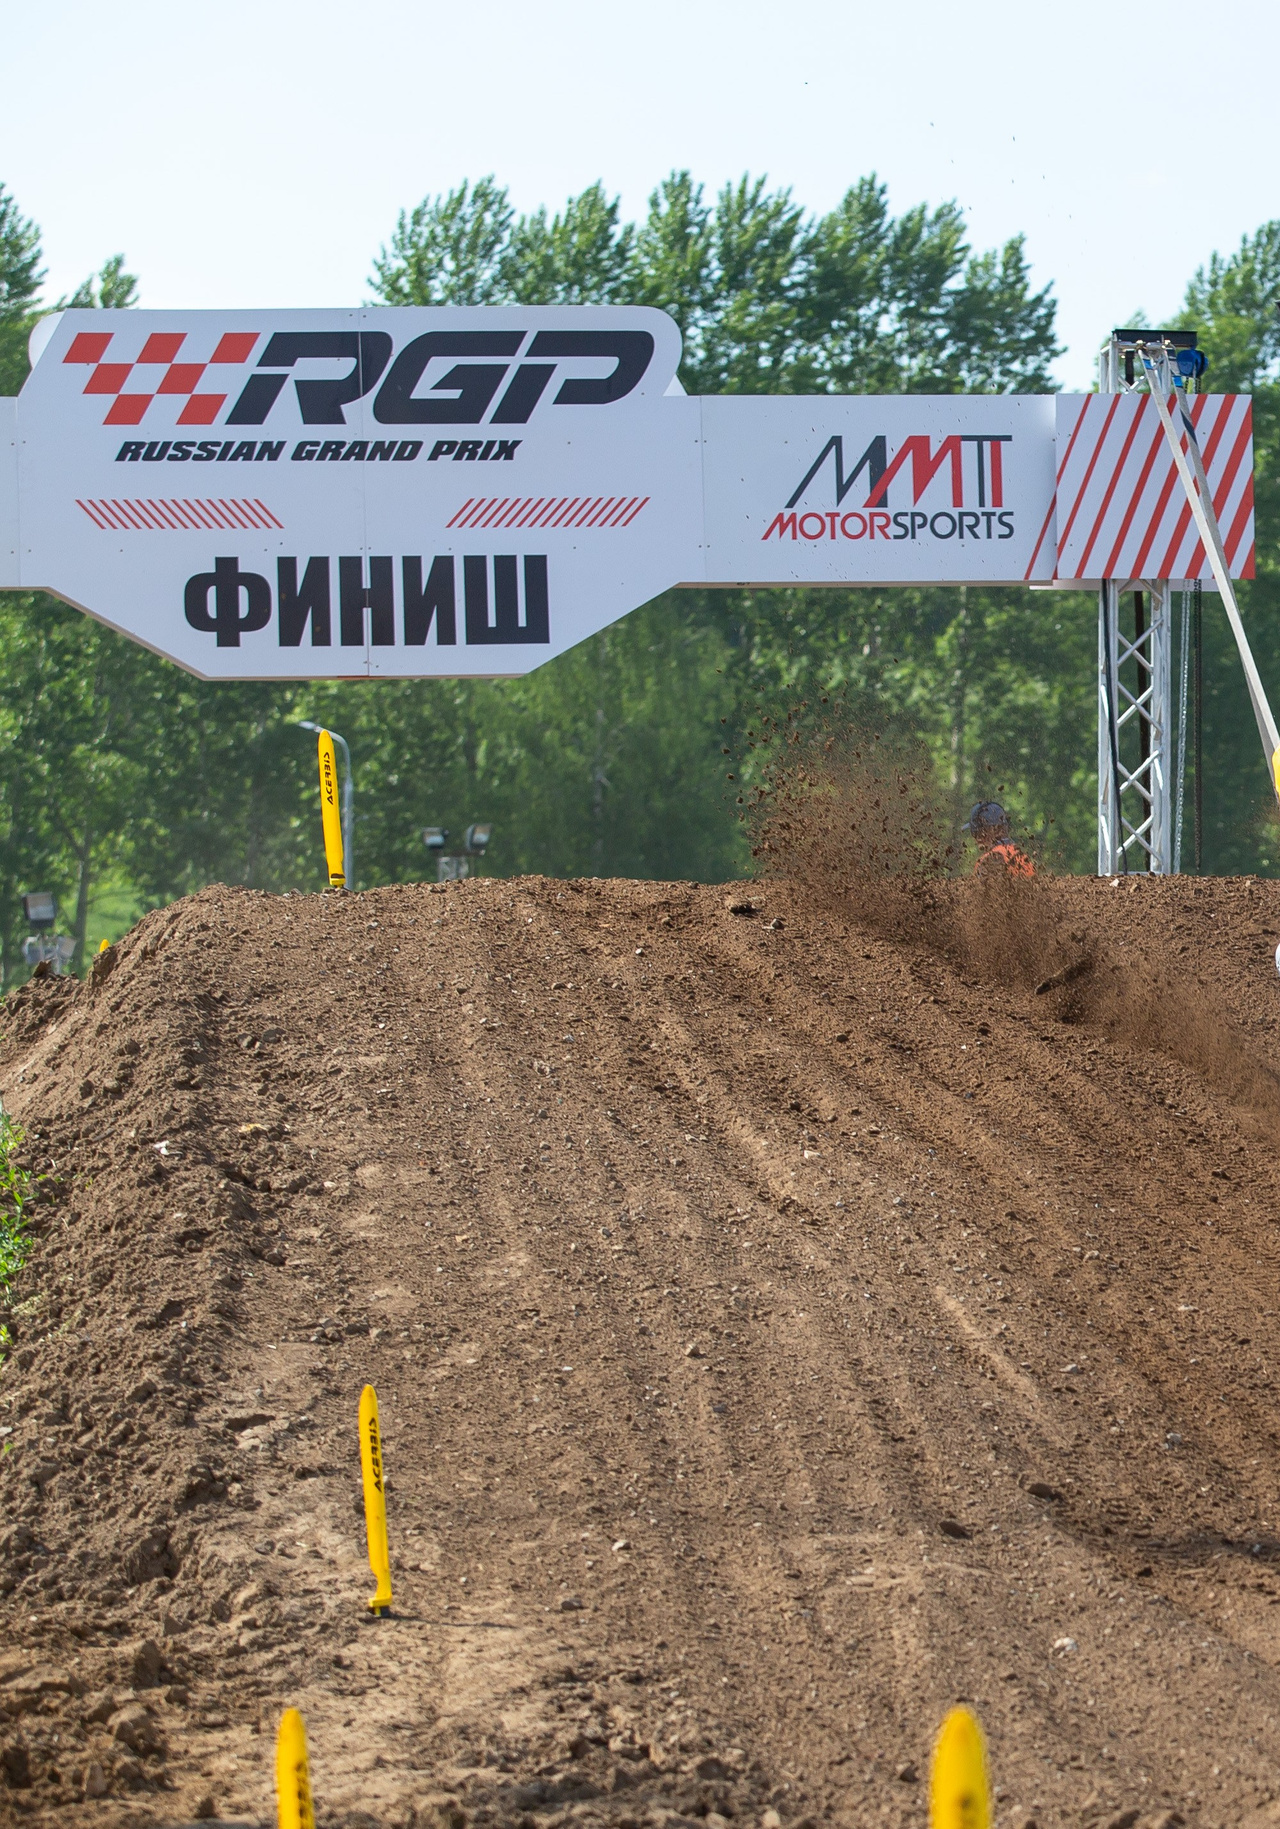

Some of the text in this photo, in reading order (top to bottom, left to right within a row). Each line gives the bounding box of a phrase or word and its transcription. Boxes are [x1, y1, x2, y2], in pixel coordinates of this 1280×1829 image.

[224, 330, 655, 426] RGP
[114, 438, 524, 462] RUSSIAN GRAND PRIX
[761, 510, 1014, 541] MOTORSPORTS
[183, 554, 551, 648] ФИНИШ
